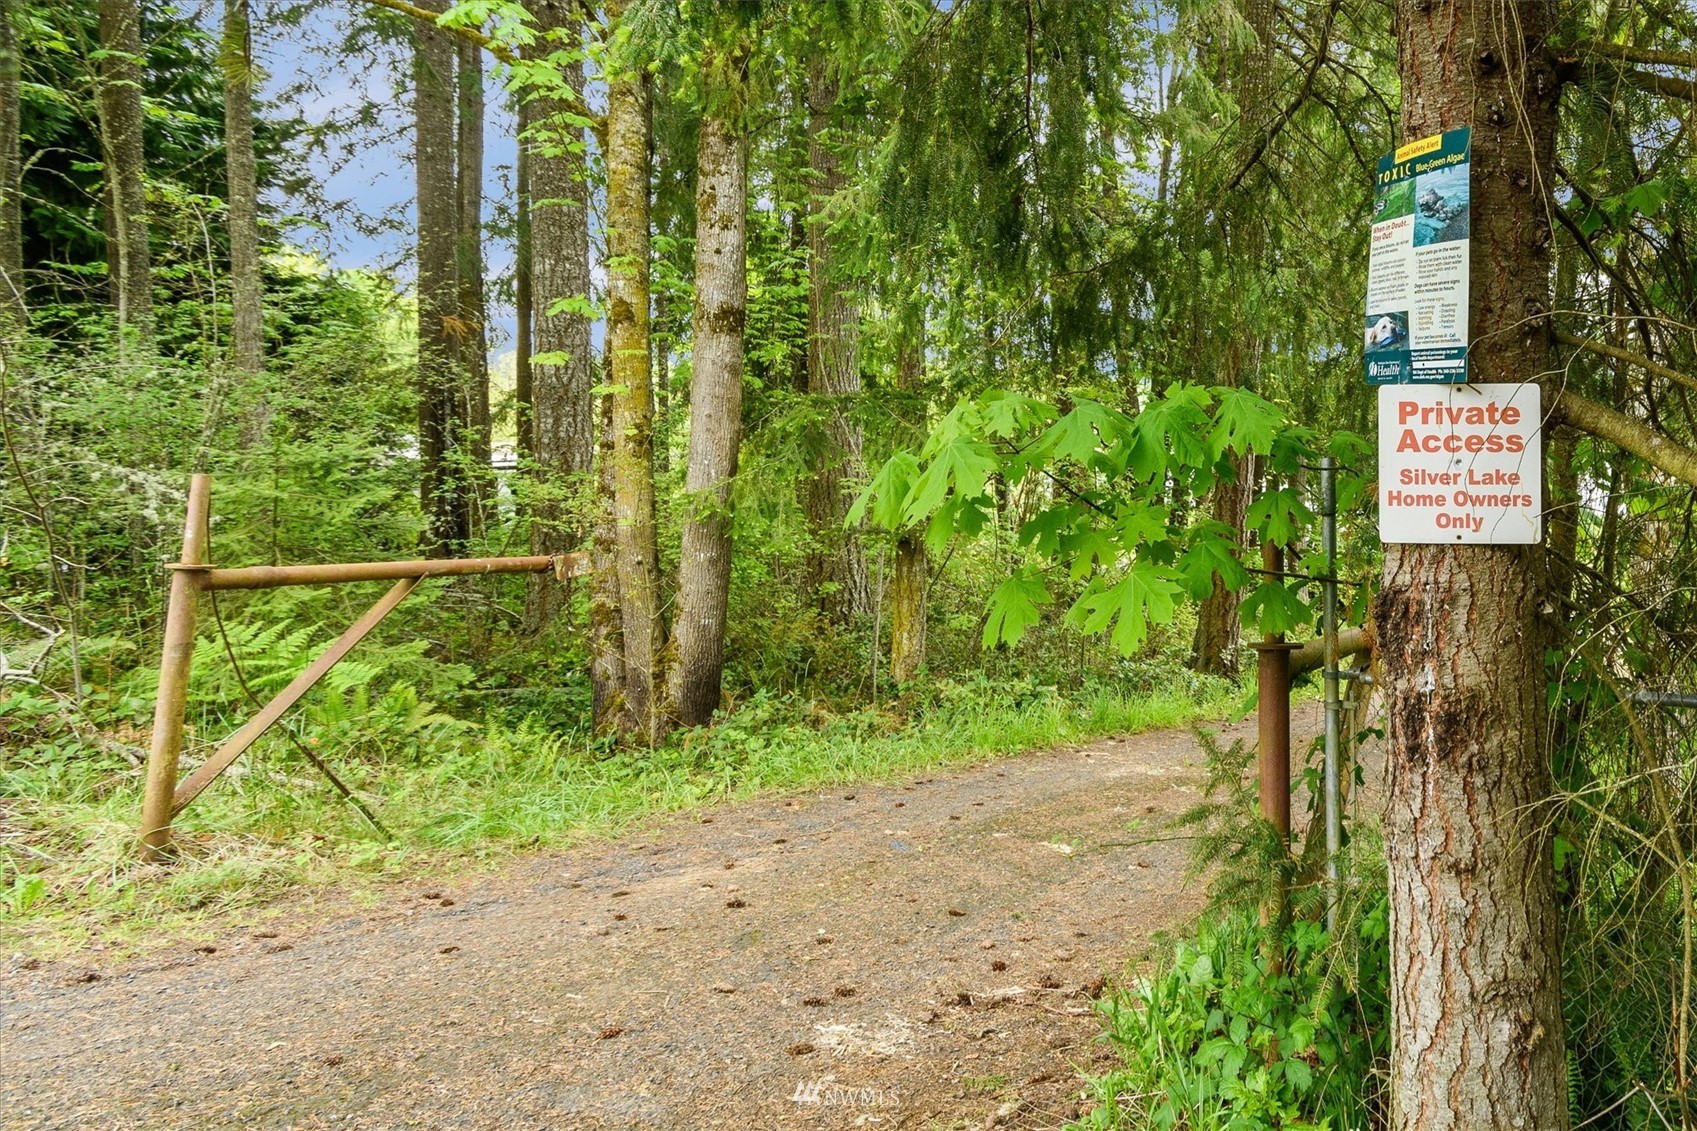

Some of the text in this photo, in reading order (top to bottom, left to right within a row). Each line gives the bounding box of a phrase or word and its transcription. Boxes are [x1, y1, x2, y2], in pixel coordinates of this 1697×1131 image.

[1397, 140, 1439, 160] Animal Safety Alert
[1379, 153, 1465, 185] TOXIC Blue-Green Algae
[1373, 231, 1393, 243] Stay Out!
[1378, 365, 1399, 375] Health
[1398, 401, 1520, 425] Private
[1396, 429, 1524, 453] Access
[1400, 468, 1520, 485] Silver Lake
[1388, 490, 1532, 507] Home Owners
[1436, 513, 1483, 532] Only
